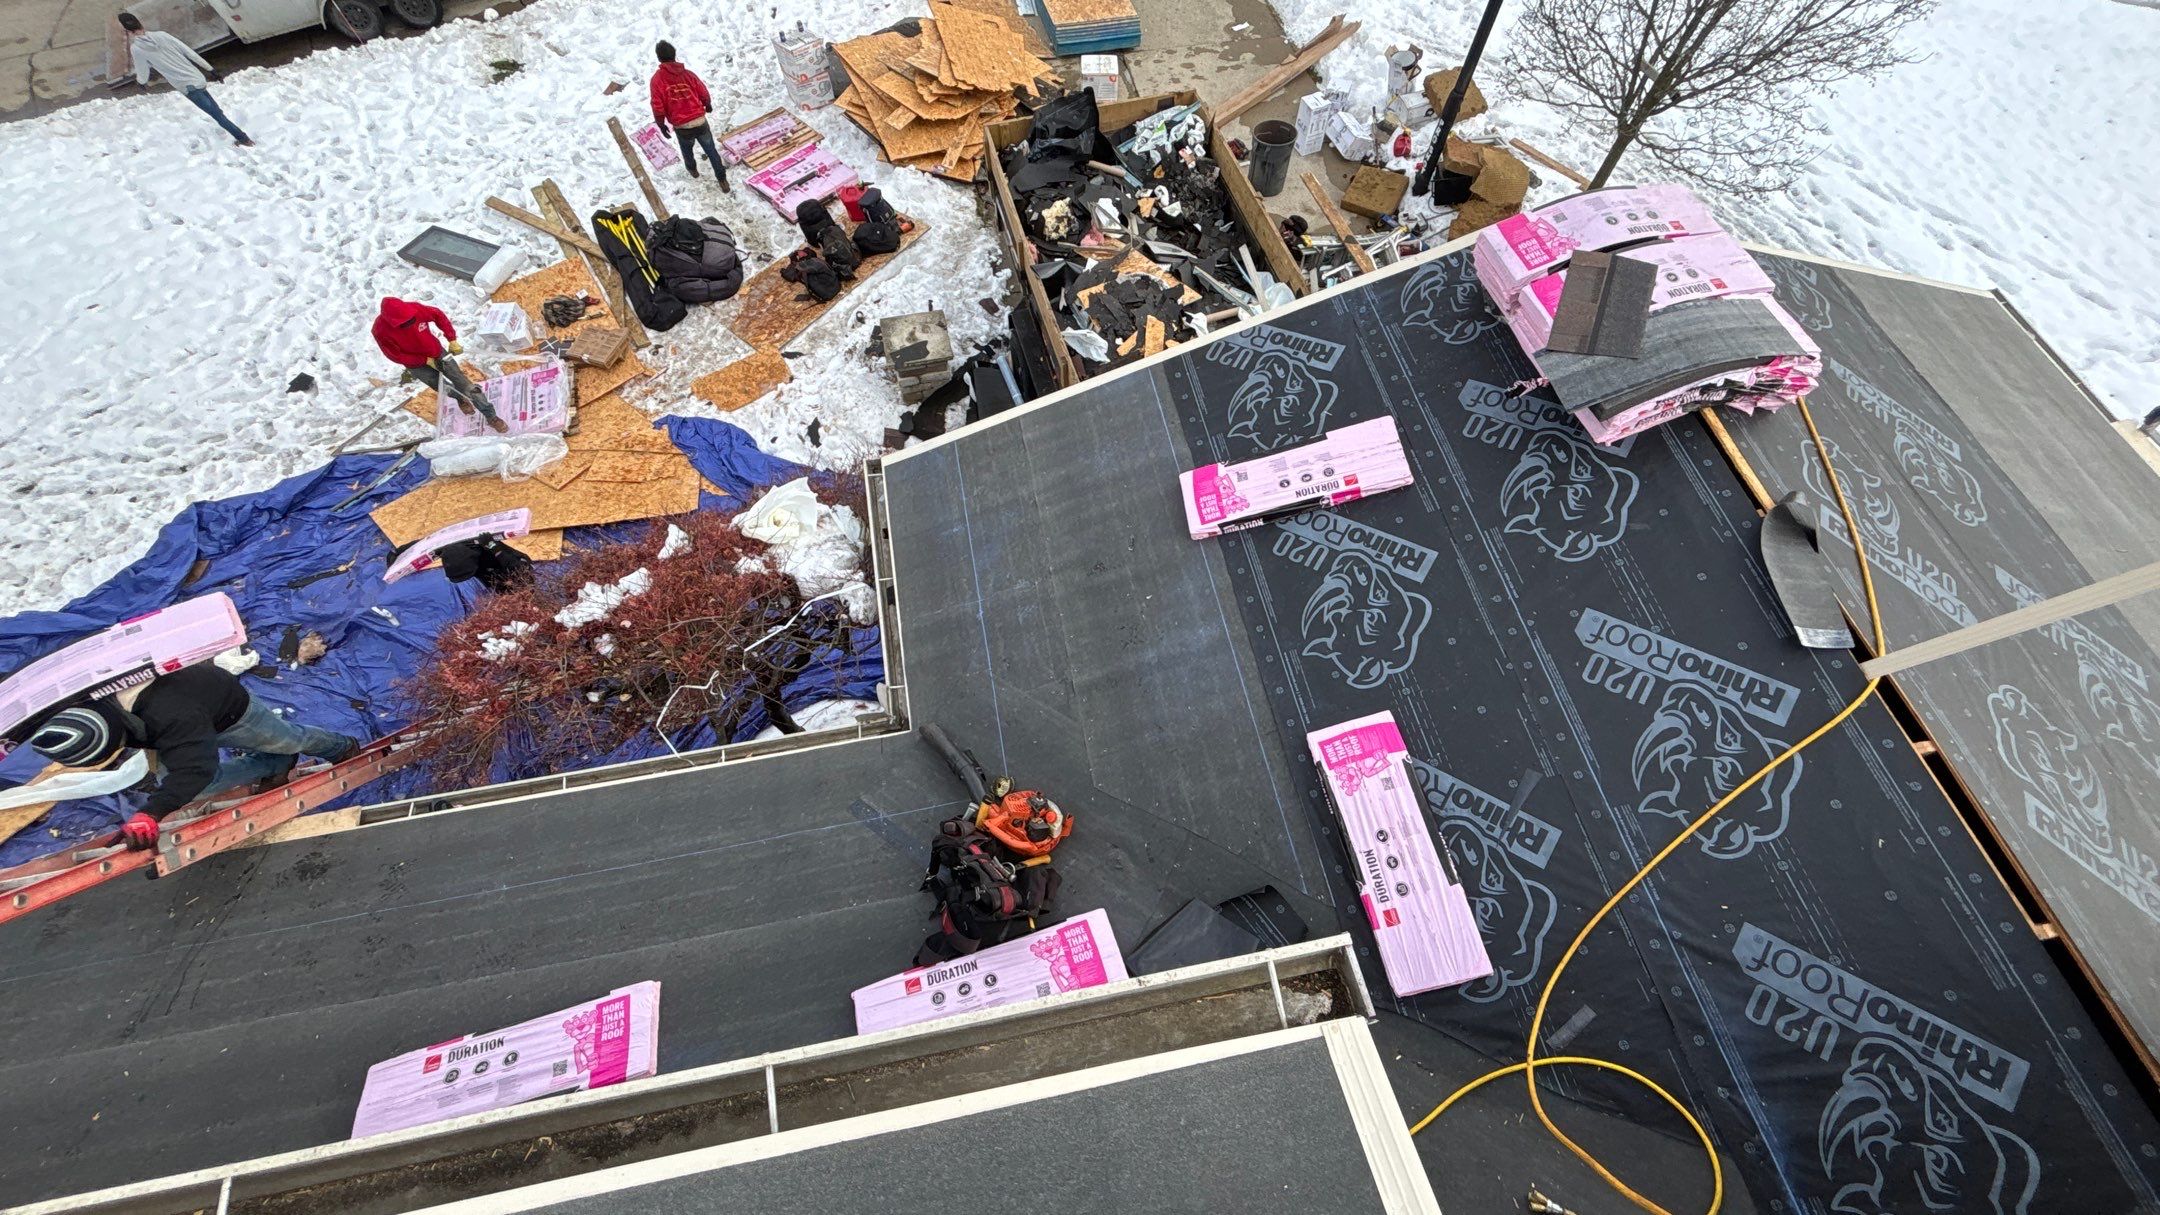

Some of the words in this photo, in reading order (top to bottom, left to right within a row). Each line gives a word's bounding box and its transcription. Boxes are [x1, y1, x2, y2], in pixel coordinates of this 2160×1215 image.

[1627, 223, 1670, 235] DURATION
[1517, 238, 1537, 249] ROOF
[1524, 249, 1545, 261] THAN
[1529, 254, 1550, 267] MORE
[1667, 283, 1710, 298] DURATION
[1205, 341, 1255, 370] U20
[1240, 328, 1338, 364] RhinoRo
[1839, 366, 1957, 456] RhinoRoof
[1846, 384, 1889, 424] U20
[1462, 414, 1525, 451] U20
[1295, 481, 1340, 498] DURATION
[1201, 505, 1220, 515] THAN
[1204, 512, 1222, 522] MORE
[1272, 532, 1331, 571] U20
[1907, 547, 1959, 596] U20
[1585, 618, 1787, 714] RhinoRoof
[1582, 652, 1656, 705] U20
[1324, 744, 1339, 764] MORE
[1333, 738, 1347, 761] THAN
[1348, 734, 1363, 755] ROOF
[2119, 836, 2160, 885] U2
[1365, 848, 1388, 904] DURATION
[1064, 925, 1086, 941] MORE
[1067, 934, 1089, 948] THAN
[1071, 944, 1086, 956] JUST
[1072, 949, 1094, 964] ROOF
[926, 959, 979, 987] DURATION
[602, 1001, 625, 1014] MORE
[602, 1010, 625, 1024] THAN
[1745, 939, 2012, 1094] RhinoRoof
[601, 1021, 618, 1033] JUST
[1744, 983, 1841, 1062] U20
[601, 1028, 625, 1042] ROOF
[447, 1036, 505, 1064] DURATION
